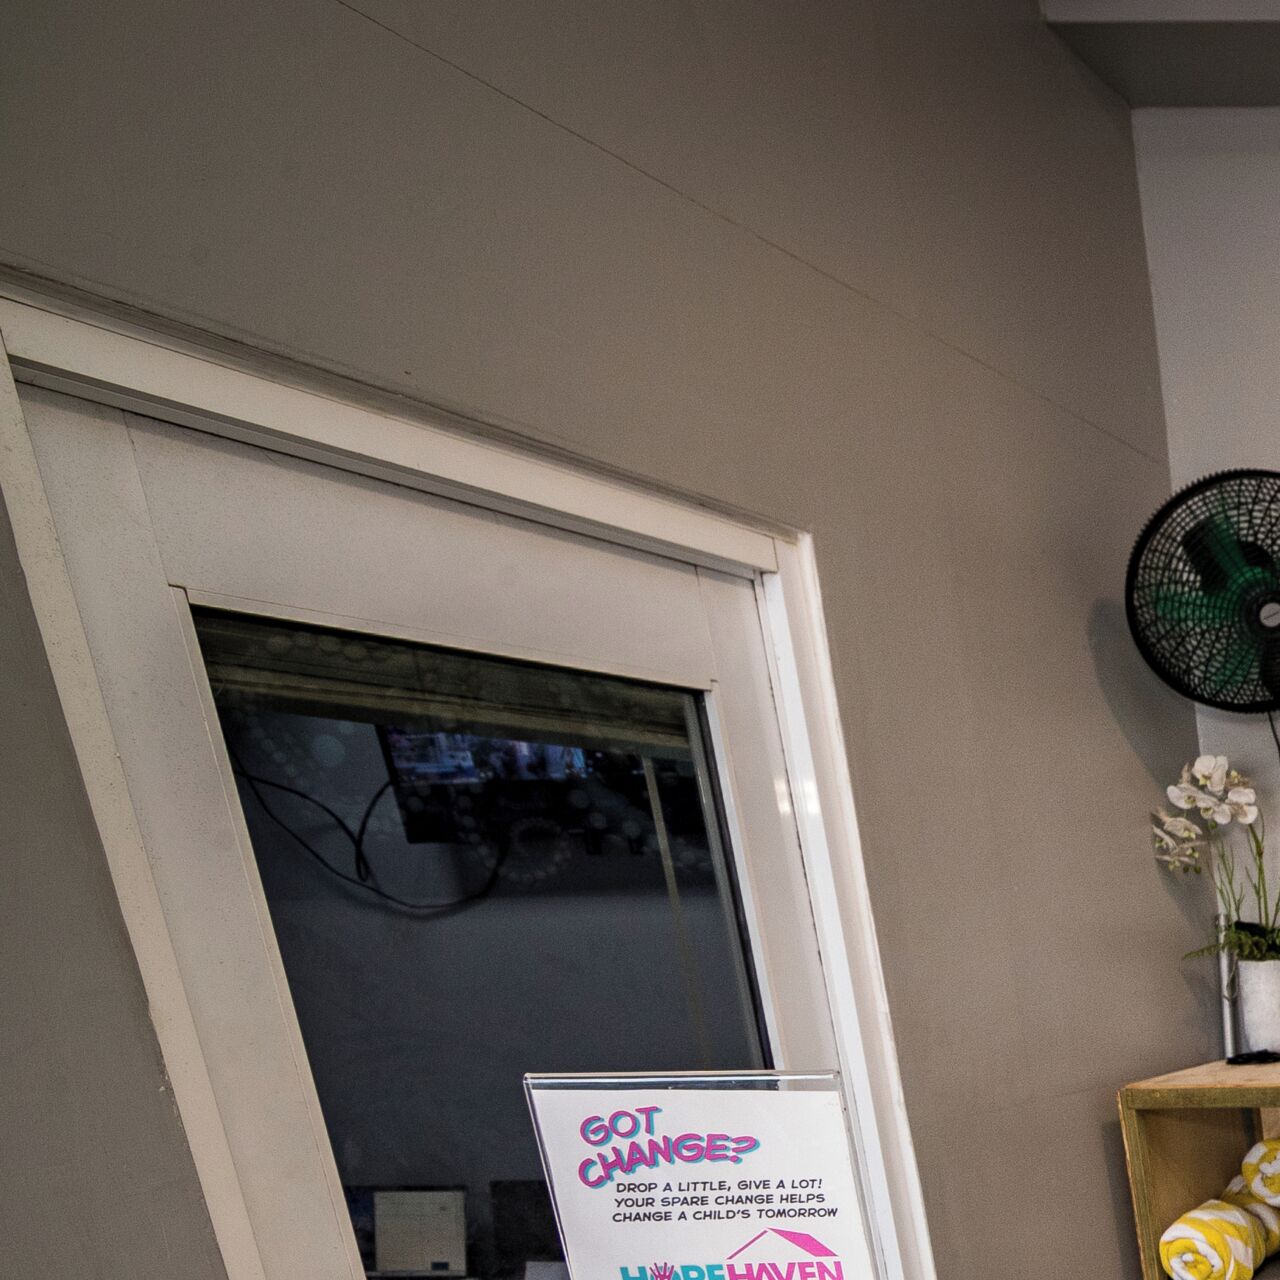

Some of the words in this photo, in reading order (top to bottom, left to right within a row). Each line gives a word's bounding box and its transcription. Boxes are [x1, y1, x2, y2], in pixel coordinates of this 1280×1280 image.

[580, 1105, 662, 1147] GOT
[578, 1132, 760, 1189] CHANGE?
[616, 1182, 658, 1193] DROP
[662, 1182, 673, 1192] A
[678, 1180, 732, 1192] LITTLE,
[737, 1180, 772, 1191] GIVE
[776, 1179, 786, 1190] A
[790, 1178, 823, 1190] LOT!
[614, 1196, 656, 1208] YOUR
[660, 1196, 710, 1207] SPARE
[714, 1194, 776, 1206] CHANGE
[780, 1193, 826, 1204] HELPS
[612, 1210, 673, 1222] CHANGE
[678, 1210, 688, 1221] A
[692, 1209, 751, 1221] CHILD'S
[756, 1206, 839, 1220] TOMORROW
